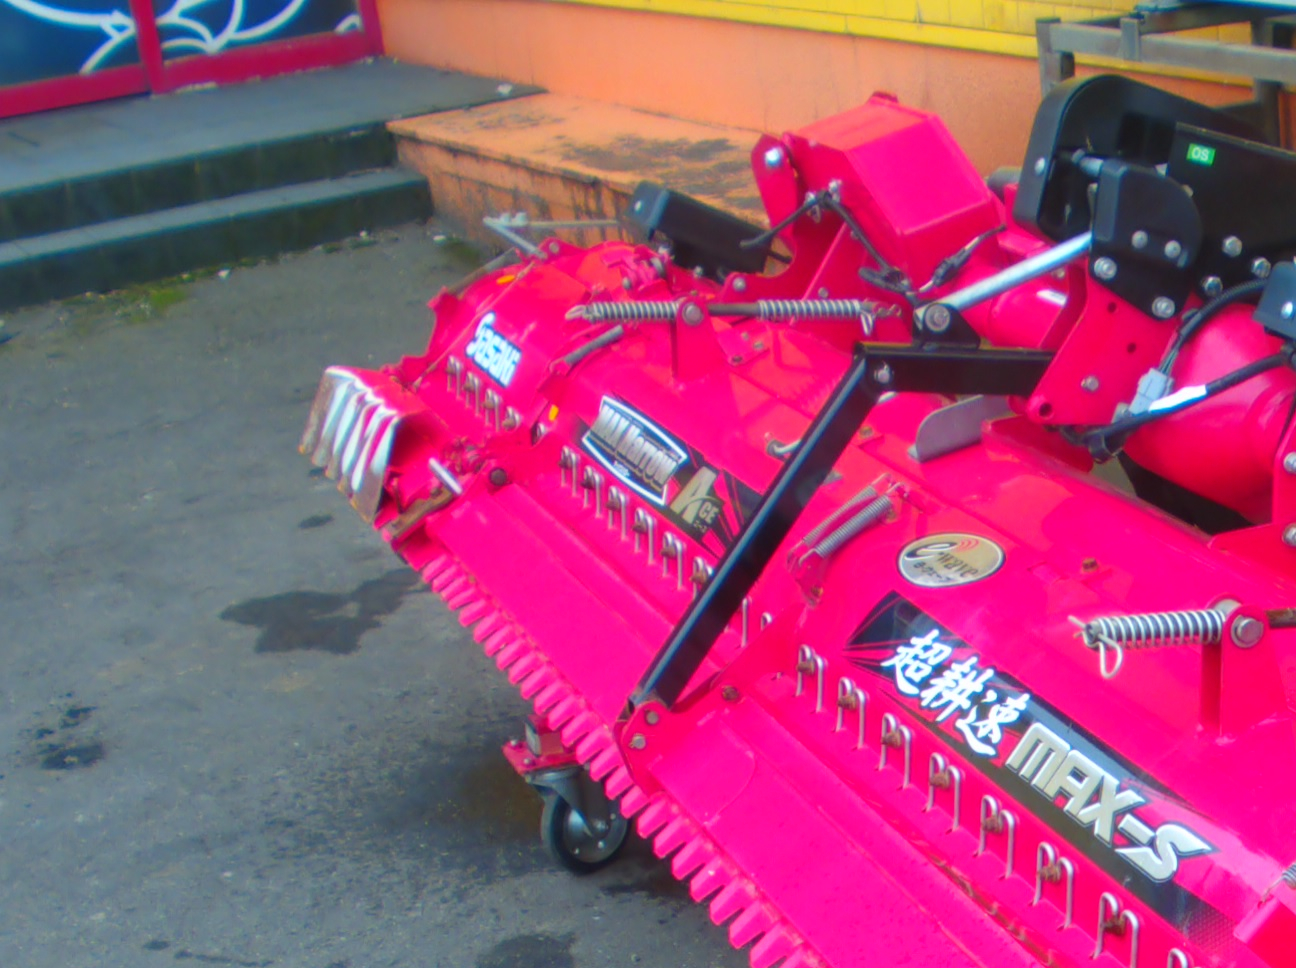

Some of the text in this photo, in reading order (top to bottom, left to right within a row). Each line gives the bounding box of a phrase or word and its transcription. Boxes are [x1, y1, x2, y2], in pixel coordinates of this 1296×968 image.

[1191, 146, 1209, 161] OS
[880, 628, 1214, 884] 超耕速 MAX-S
